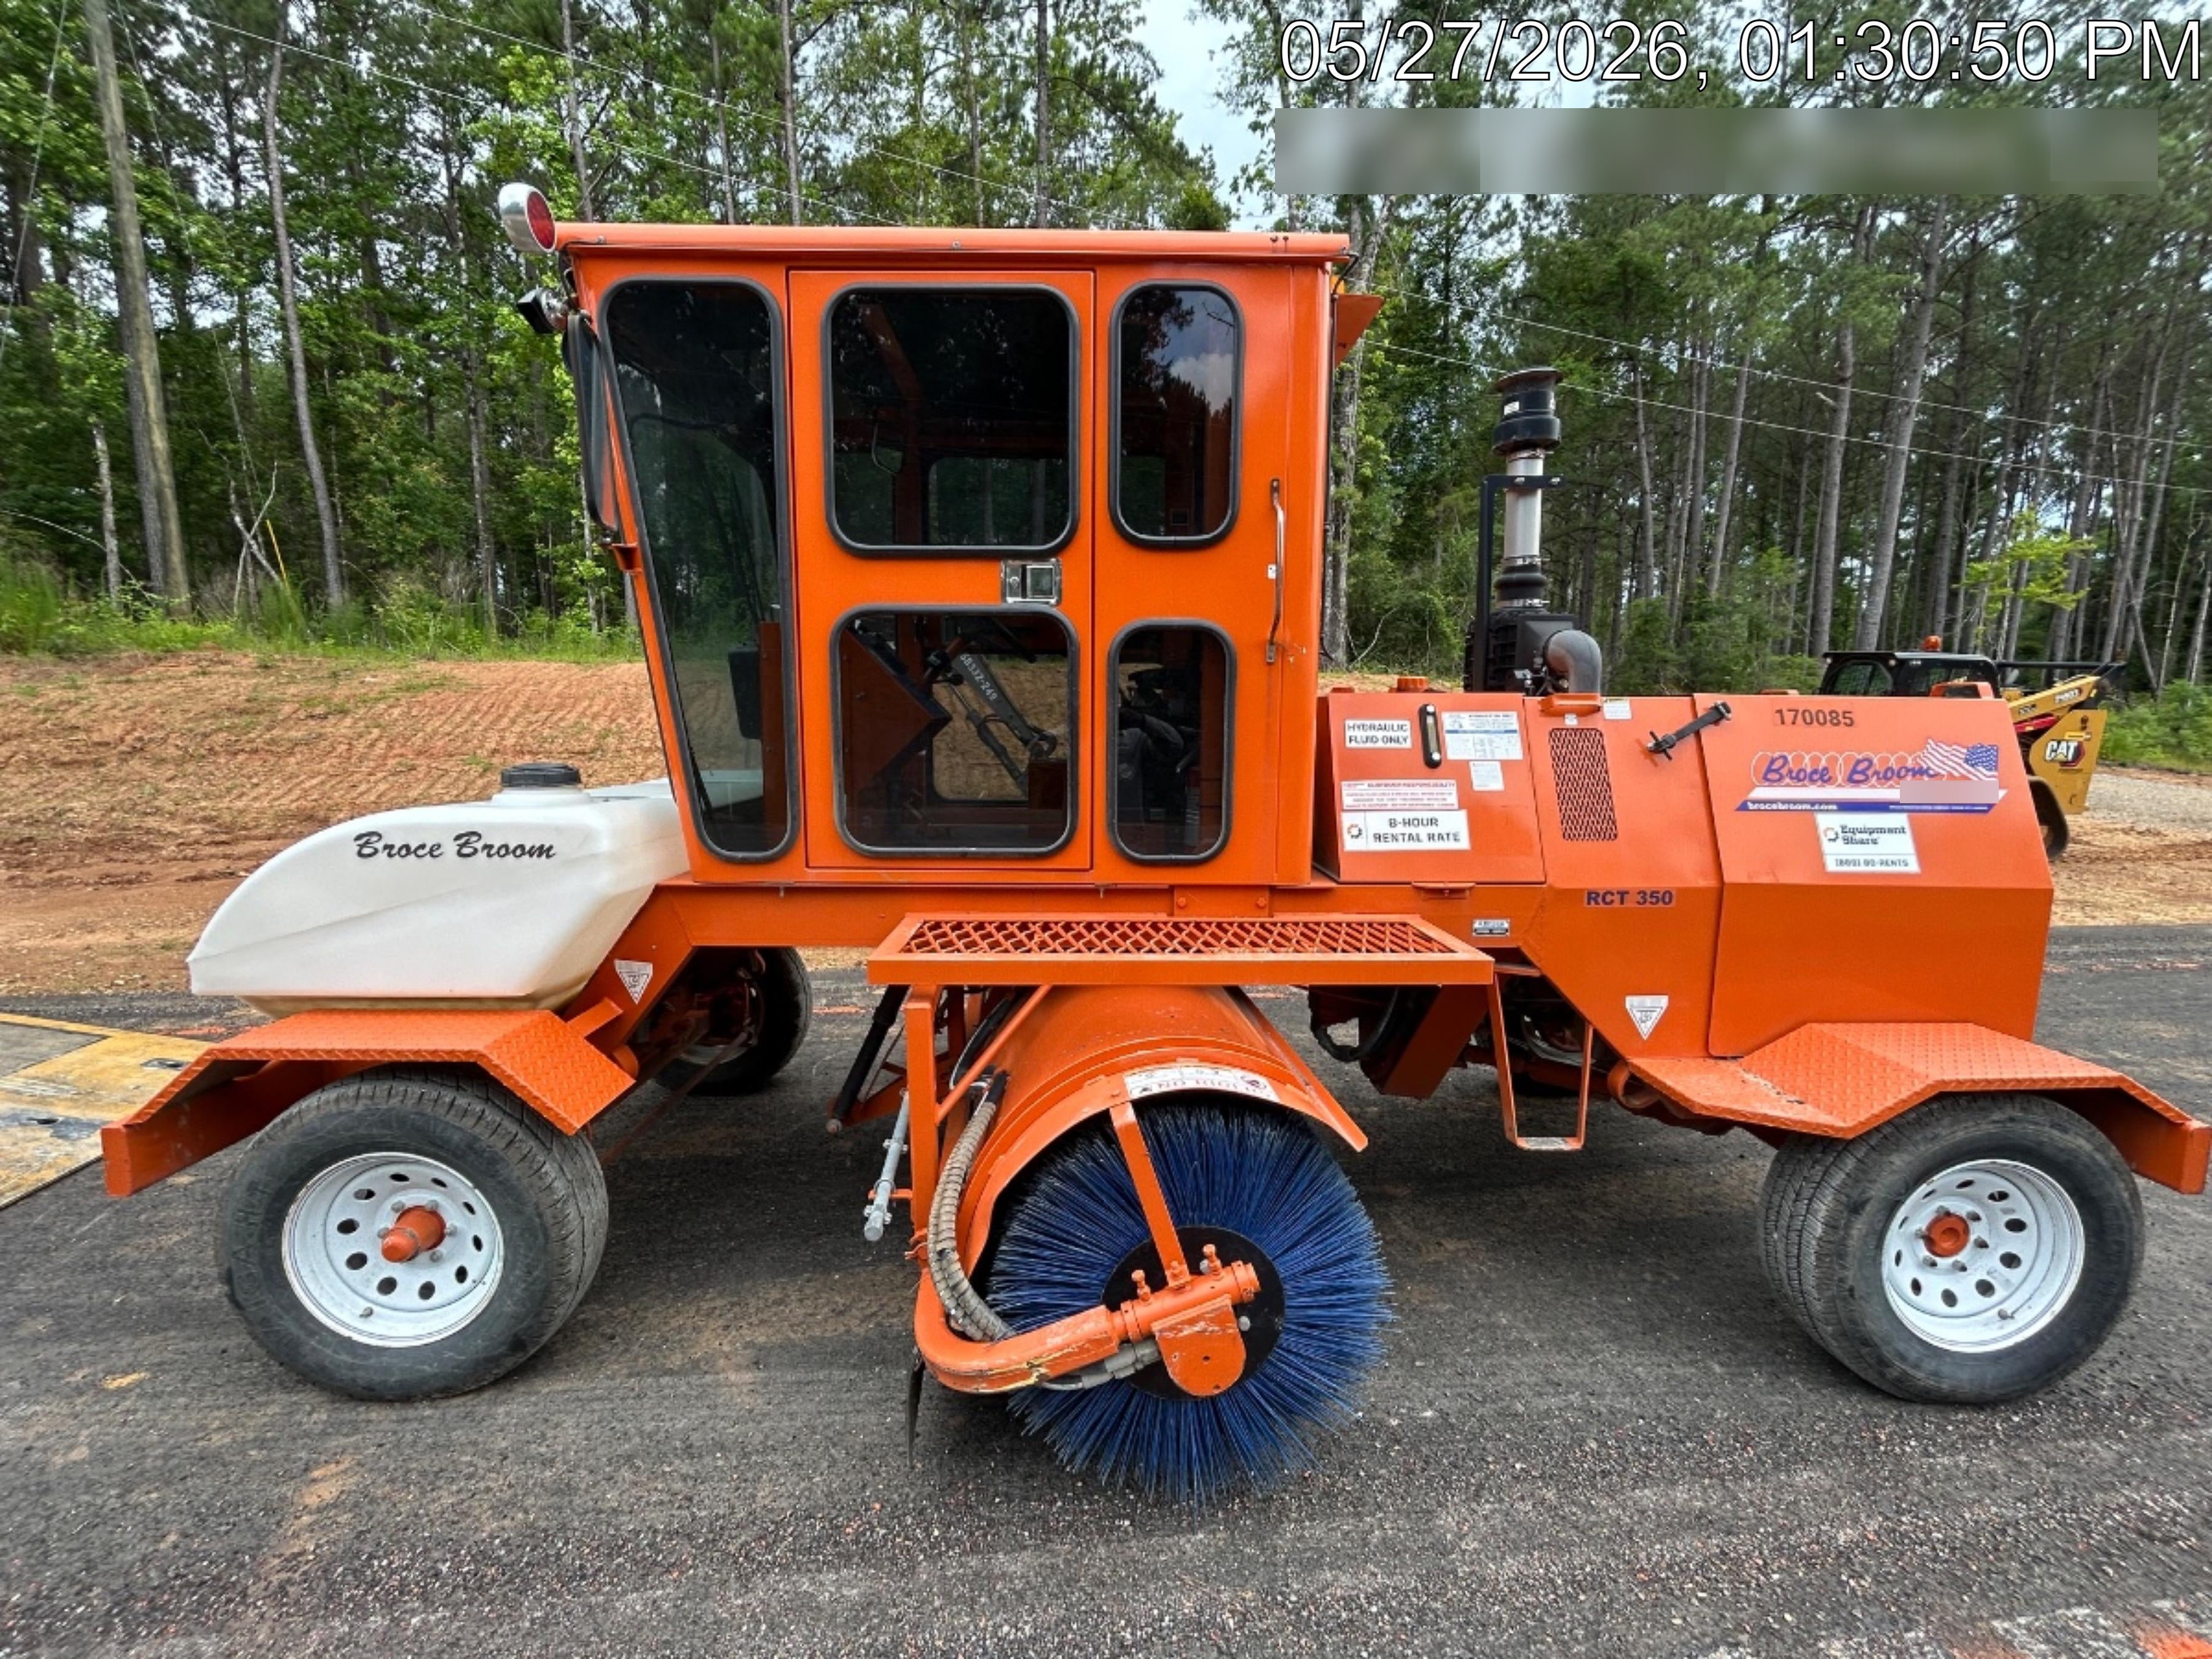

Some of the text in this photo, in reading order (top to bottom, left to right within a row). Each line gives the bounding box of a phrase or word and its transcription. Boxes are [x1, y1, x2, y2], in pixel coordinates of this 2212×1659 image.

[1775, 708, 1854, 727] 170085
[1347, 723, 1408, 732] HYDRAULIC
[1349, 735, 1409, 745] FLUID ONLY
[2045, 740, 2077, 761] CAT
[1762, 755, 1939, 785] Broce Broom
[1747, 802, 1838, 810] brocebroom.com
[1389, 818, 1438, 828] 8-HOUR
[1840, 825, 1905, 836] Equipment
[1373, 832, 1461, 843] RENTAL RATE
[1842, 836, 1878, 845] Share
[354, 831, 555, 859] Broce Broom
[1586, 890, 1674, 906] RCT 350
